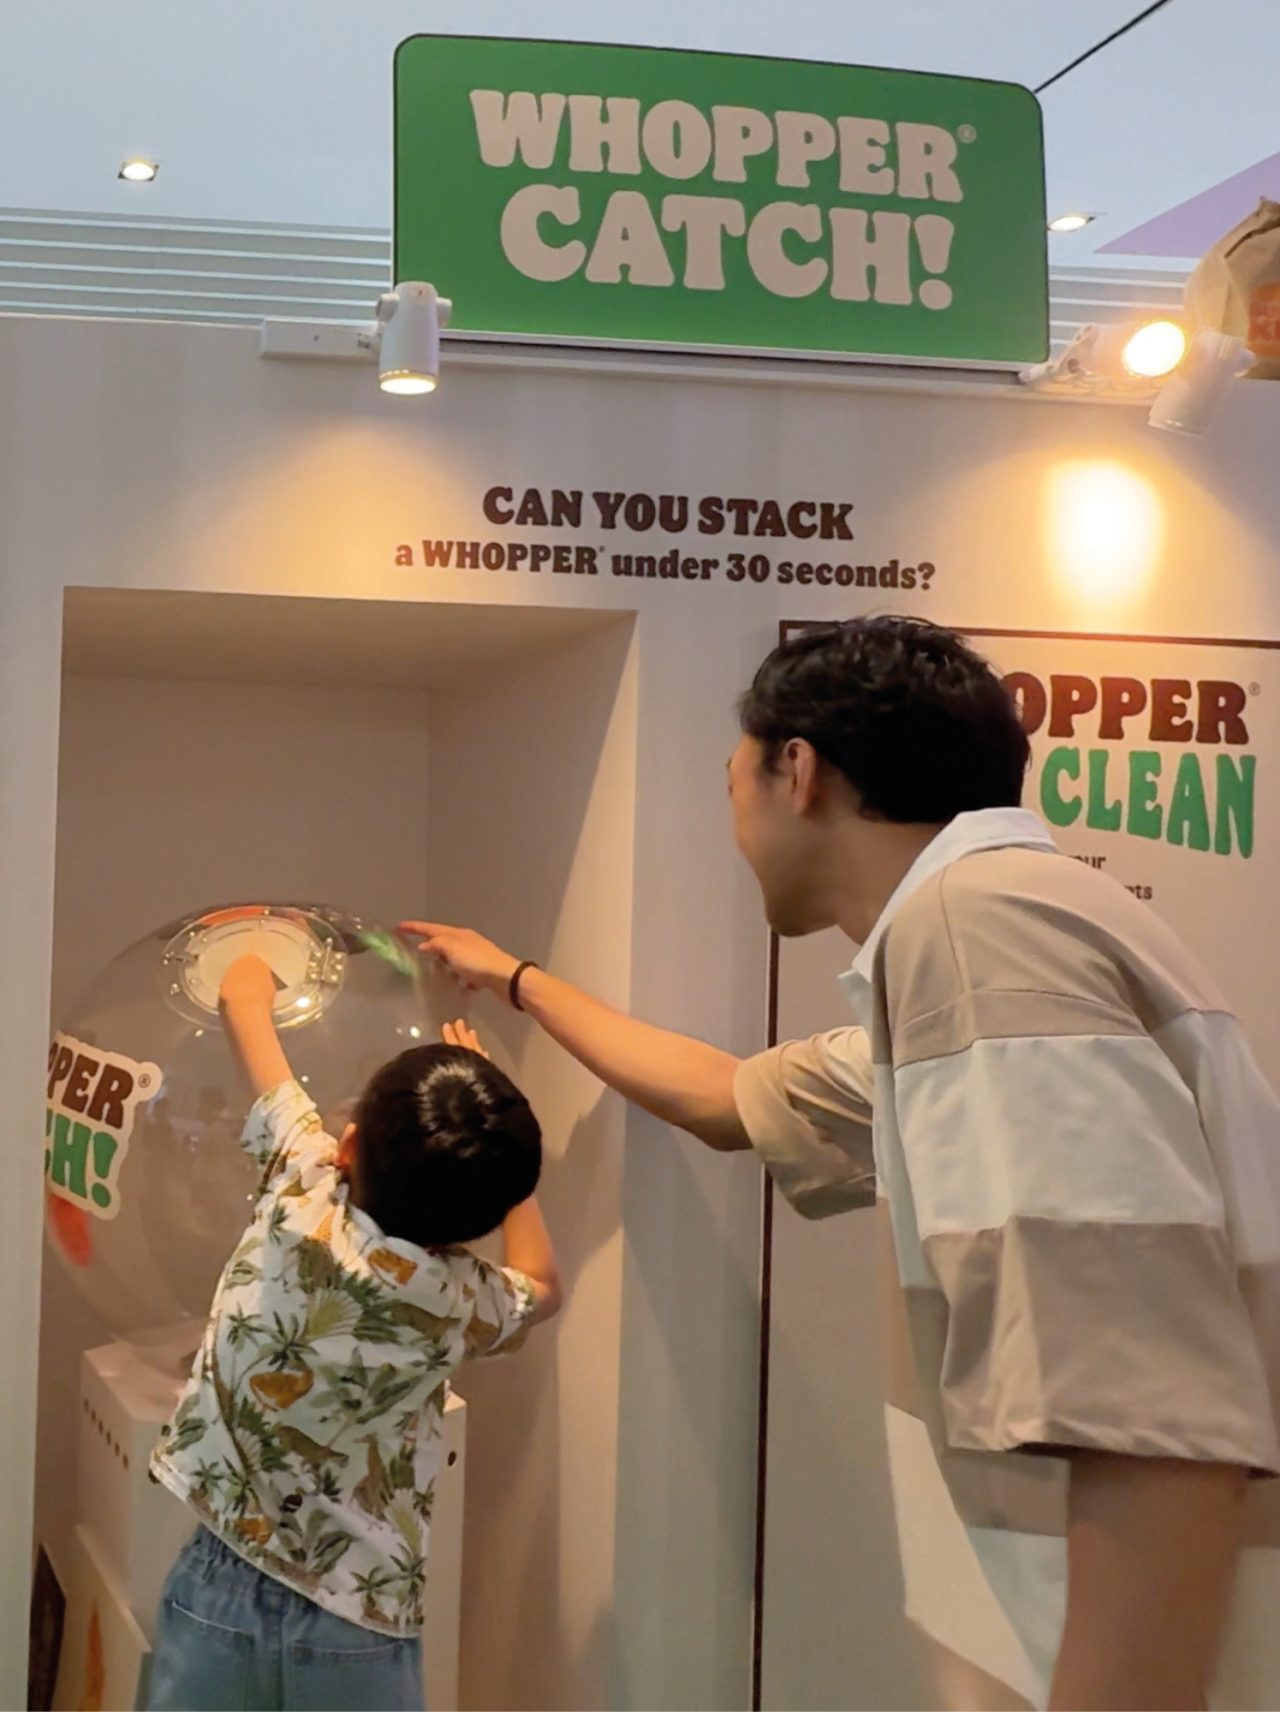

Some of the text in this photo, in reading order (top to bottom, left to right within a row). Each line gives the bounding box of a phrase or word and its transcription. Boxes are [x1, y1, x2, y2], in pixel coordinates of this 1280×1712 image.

[500, 184, 956, 310] CATCH!
[482, 487, 854, 540] CAN YOU STACK
[395, 545, 413, 566] a
[611, 550, 719, 580] under
[726, 555, 770, 582] 30
[777, 561, 936, 590] seconds?
[1040, 746, 1256, 859] CLEAN
[45, 1107, 118, 1209] H!
